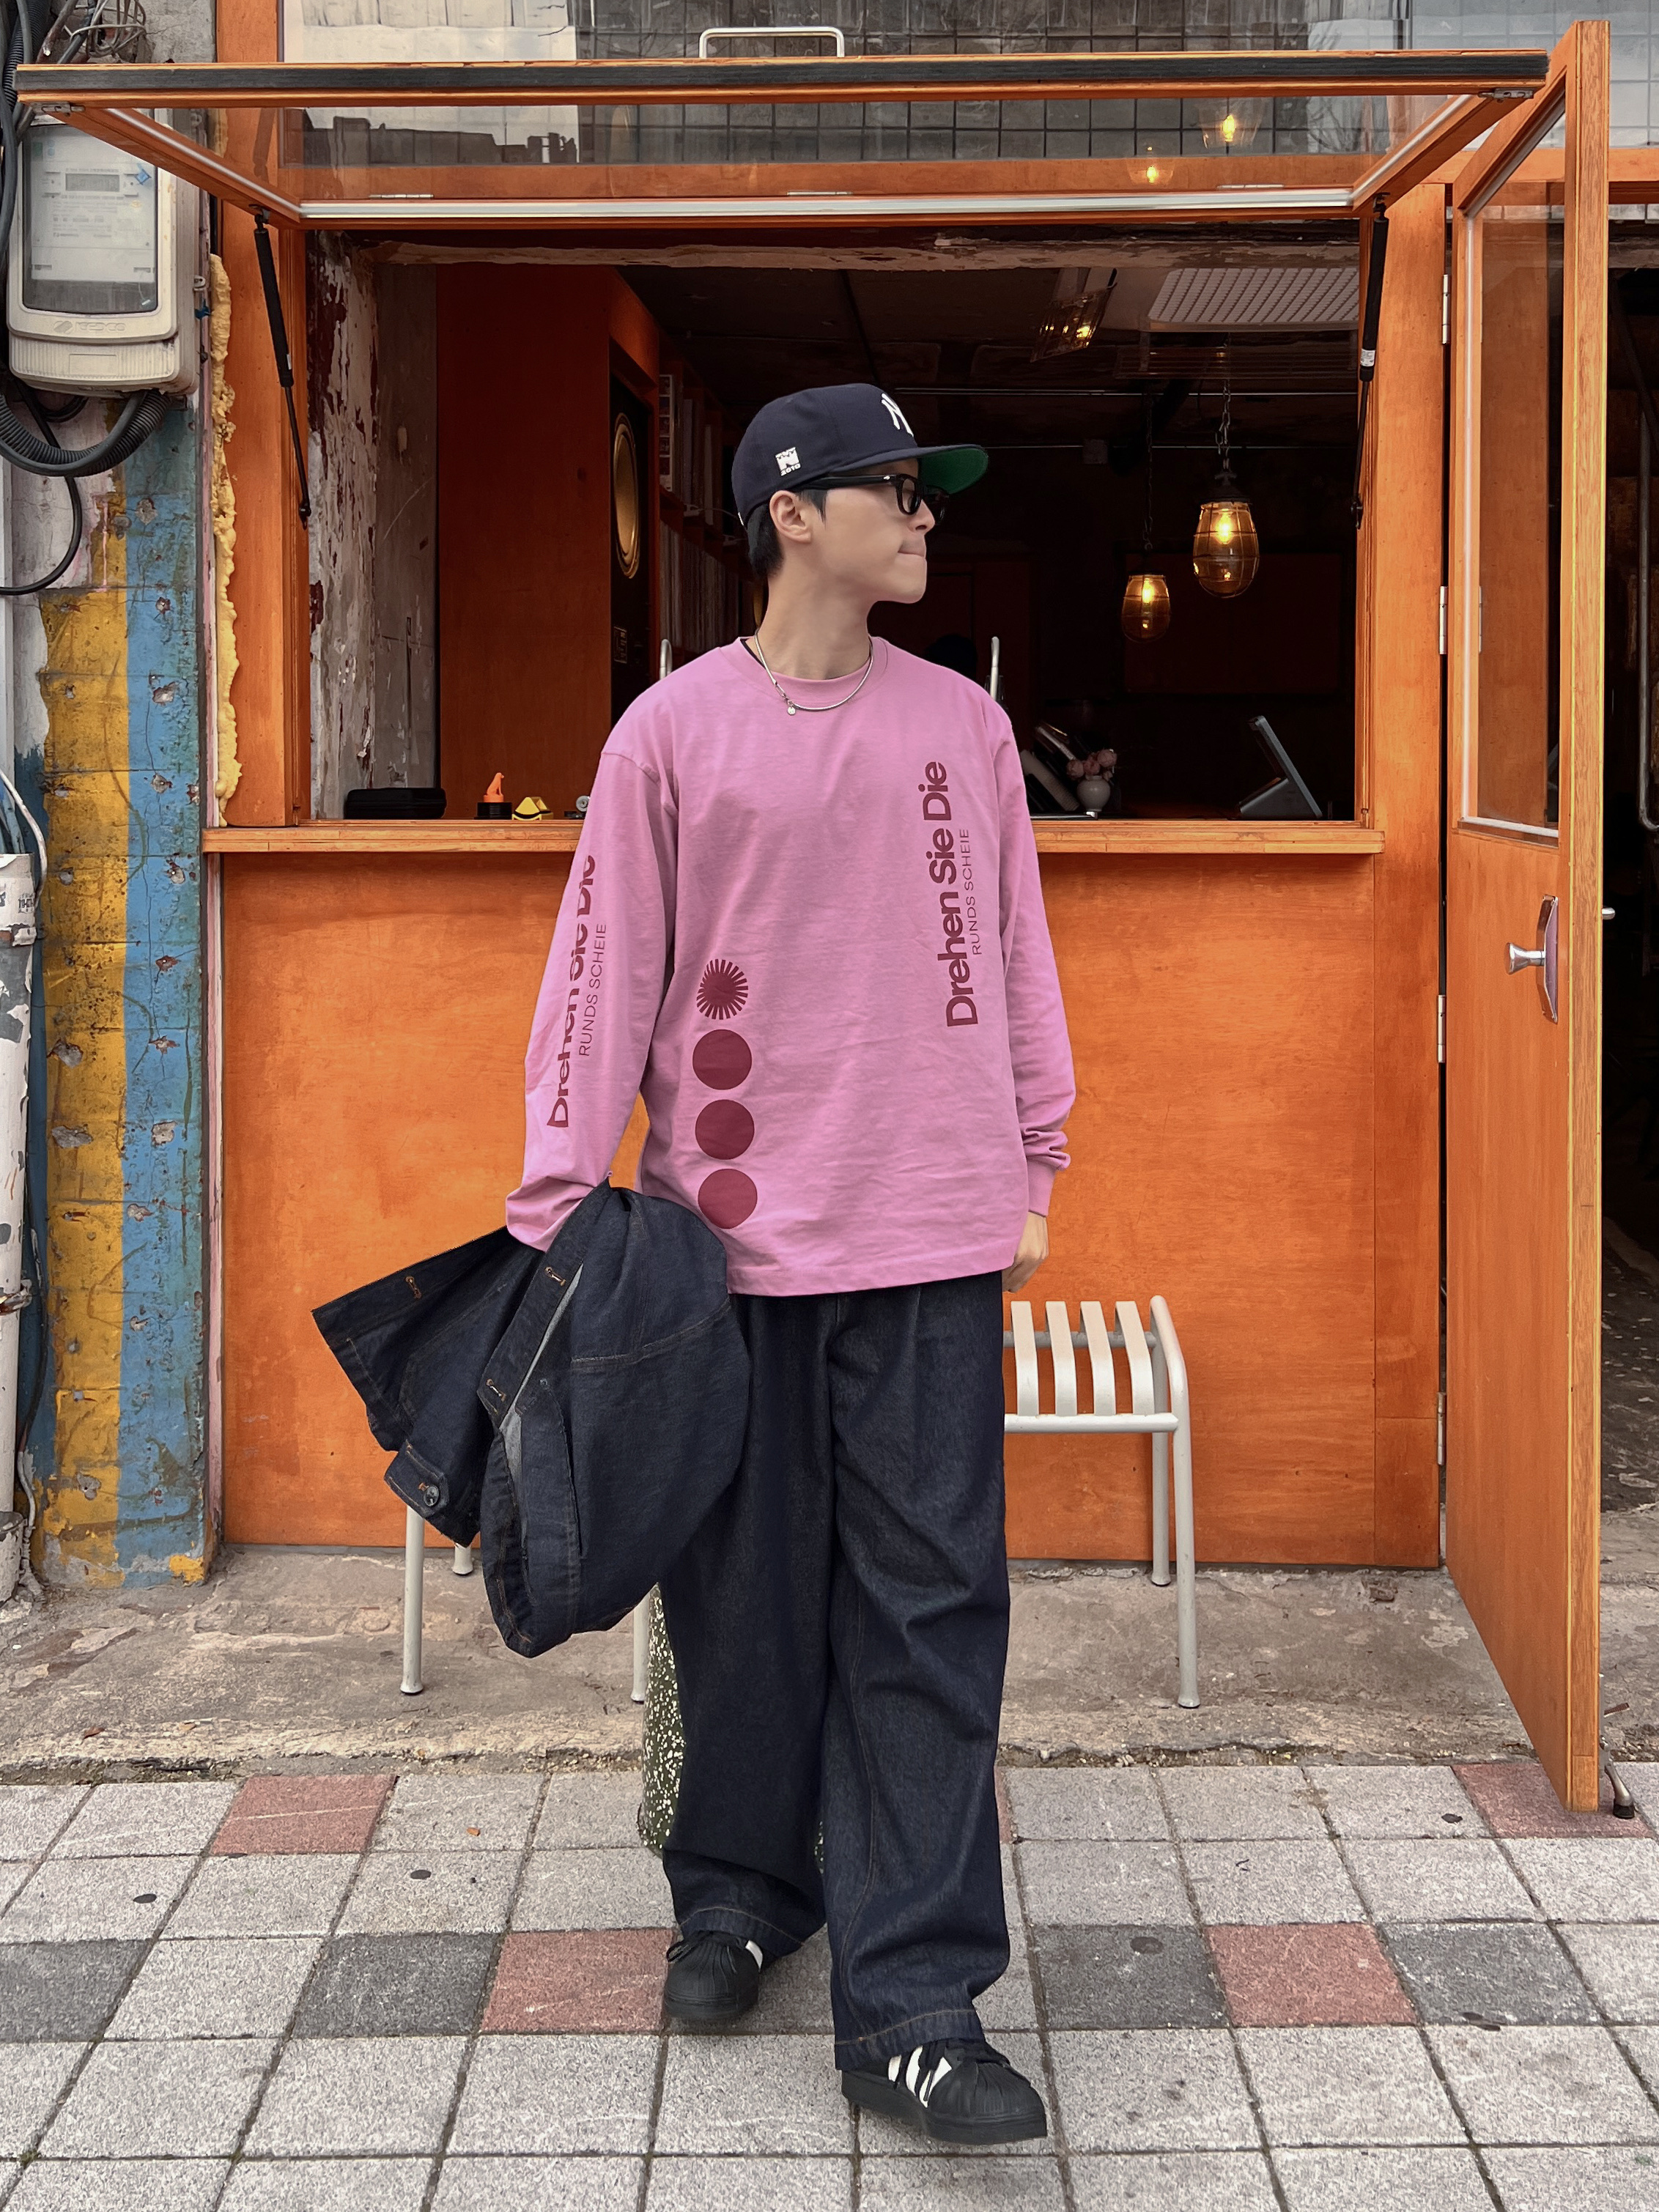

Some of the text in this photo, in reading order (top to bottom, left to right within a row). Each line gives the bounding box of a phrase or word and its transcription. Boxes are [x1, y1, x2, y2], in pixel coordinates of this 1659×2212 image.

[918, 761, 978, 1027] Drehen Sie Die
[959, 829, 983, 955] RUNDS SCHEIE
[579, 923, 607, 1057] RUNDS SCHEIE
